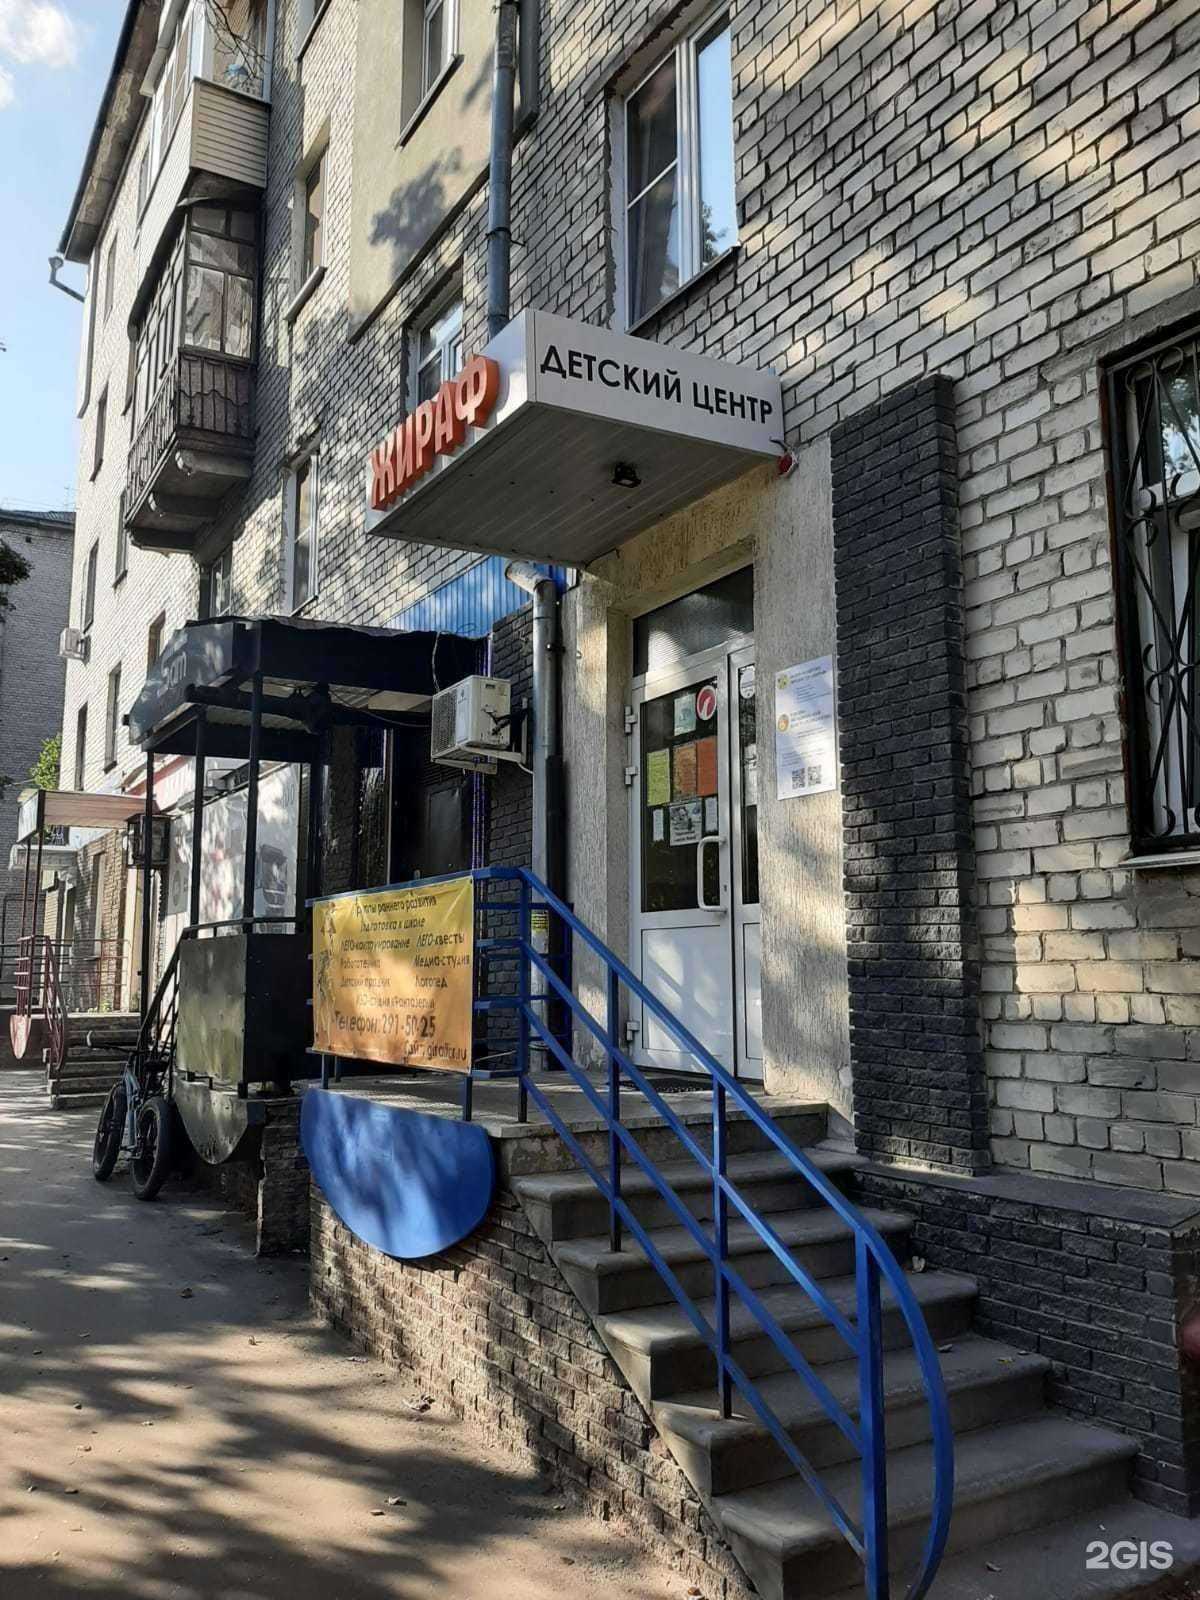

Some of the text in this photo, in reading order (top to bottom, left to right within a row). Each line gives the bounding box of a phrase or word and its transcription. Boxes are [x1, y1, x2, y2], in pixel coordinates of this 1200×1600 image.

[540, 345, 773, 424] ДЕТСКИЙ ЦЕНТР
[370, 354, 499, 511] ЖИРАФ
[416, 933, 465, 948] ЛЕГО-квесты
